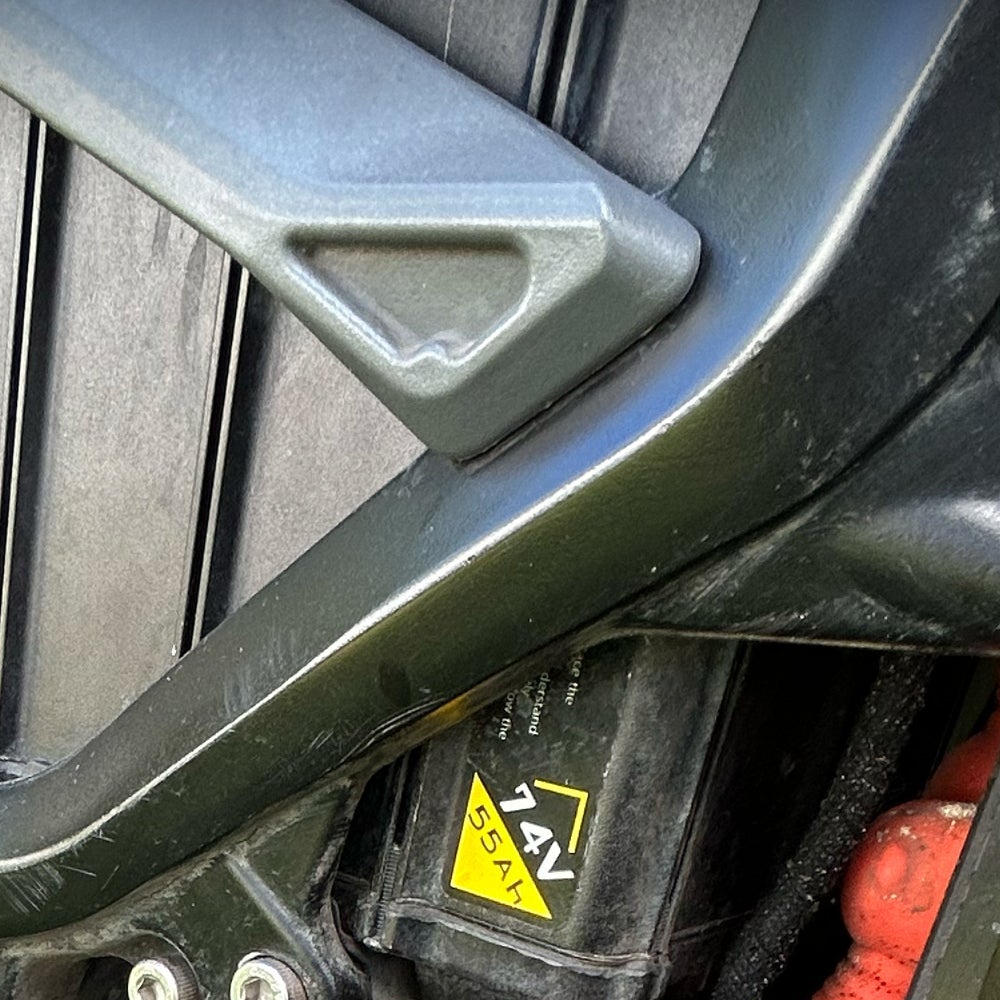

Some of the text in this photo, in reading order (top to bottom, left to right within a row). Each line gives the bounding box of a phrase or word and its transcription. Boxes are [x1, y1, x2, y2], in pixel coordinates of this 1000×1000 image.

[565, 682, 579, 706] the
[498, 717, 512, 740] the
[468, 805, 524, 904] 55Ah
[500, 782, 575, 880] 74V
